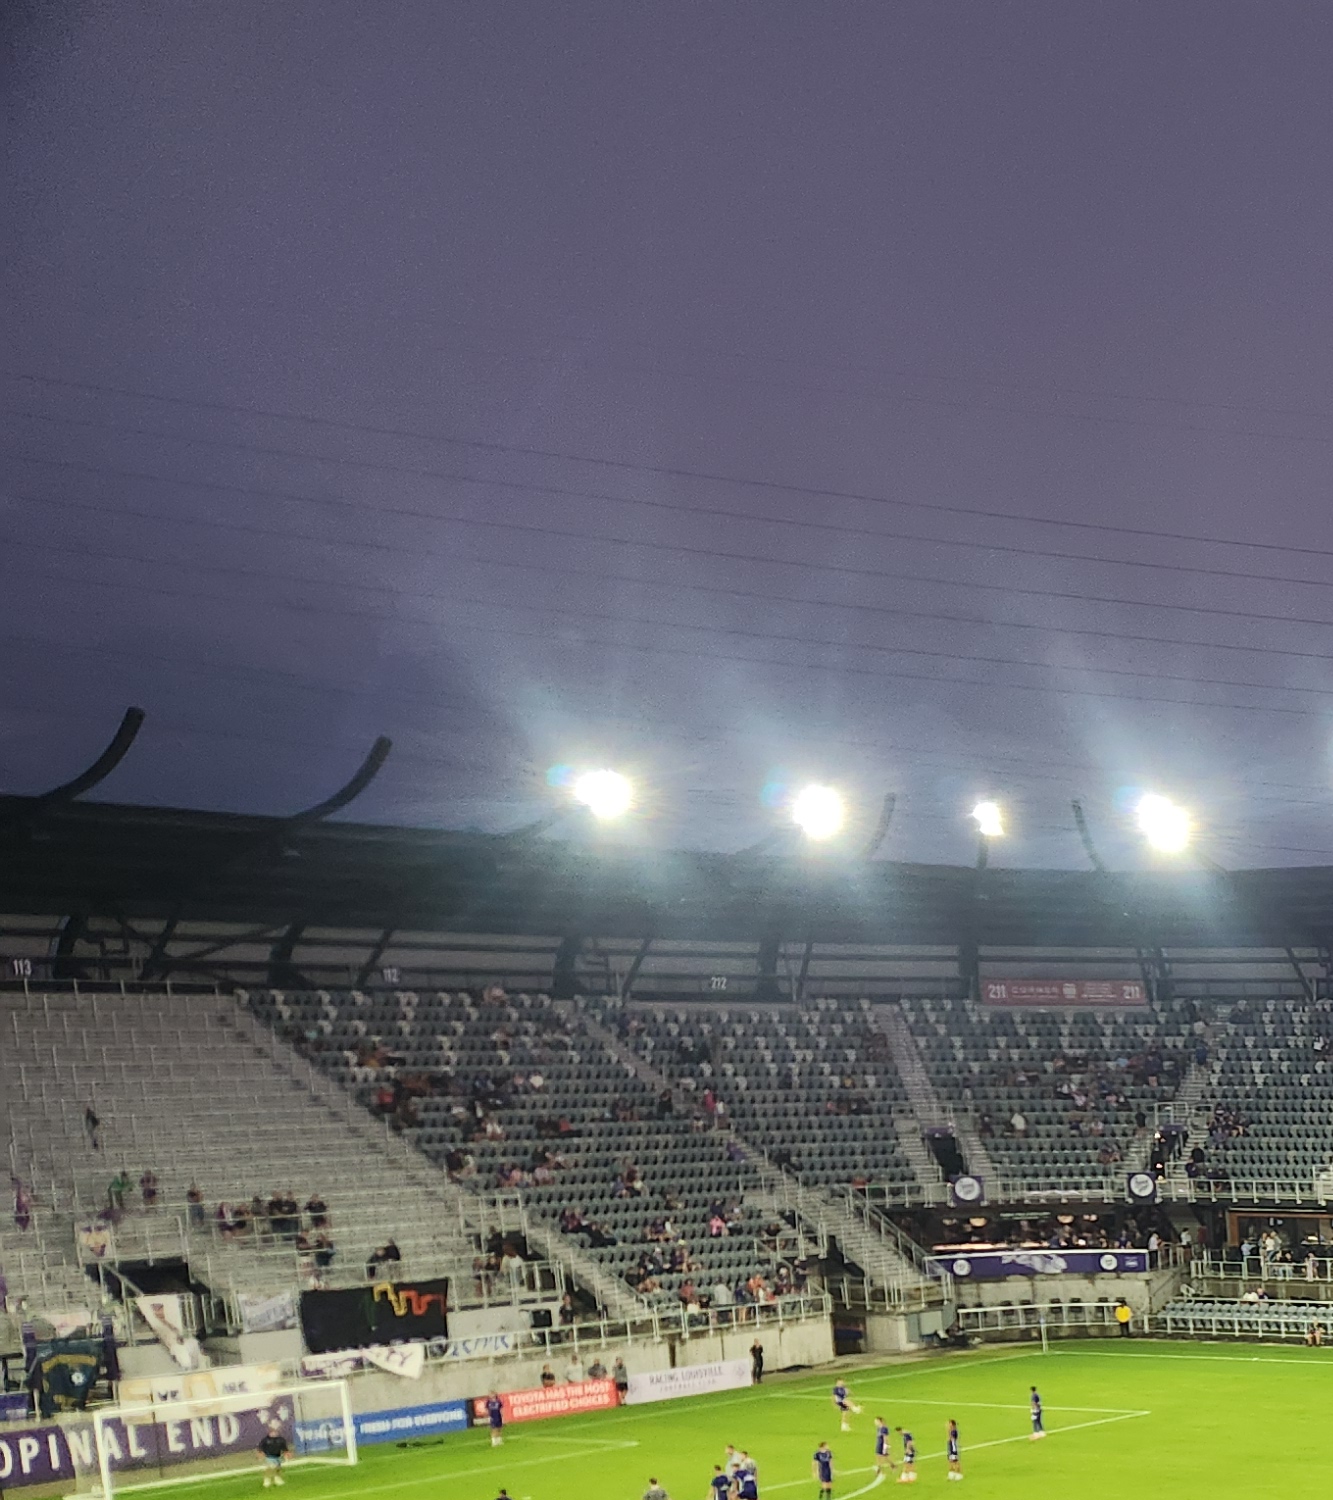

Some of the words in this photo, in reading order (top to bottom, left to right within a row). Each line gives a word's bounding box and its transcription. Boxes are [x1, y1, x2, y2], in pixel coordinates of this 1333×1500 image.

[13, 959, 31, 976] 113
[988, 984, 1007, 999] 211
[1122, 985, 1140, 999] 211
[649, 1373, 679, 1386] RACING
[681, 1365, 723, 1381] LOUISVILLE
[508, 1390, 545, 1406] TOYOTA
[546, 1386, 566, 1401] HAS
[567, 1384, 584, 1397] THE
[584, 1380, 610, 1394] MOST
[512, 1401, 569, 1418] ELECTRIFIED
[0, 1423, 147, 1479] OPINAL
[166, 1411, 241, 1453] END
